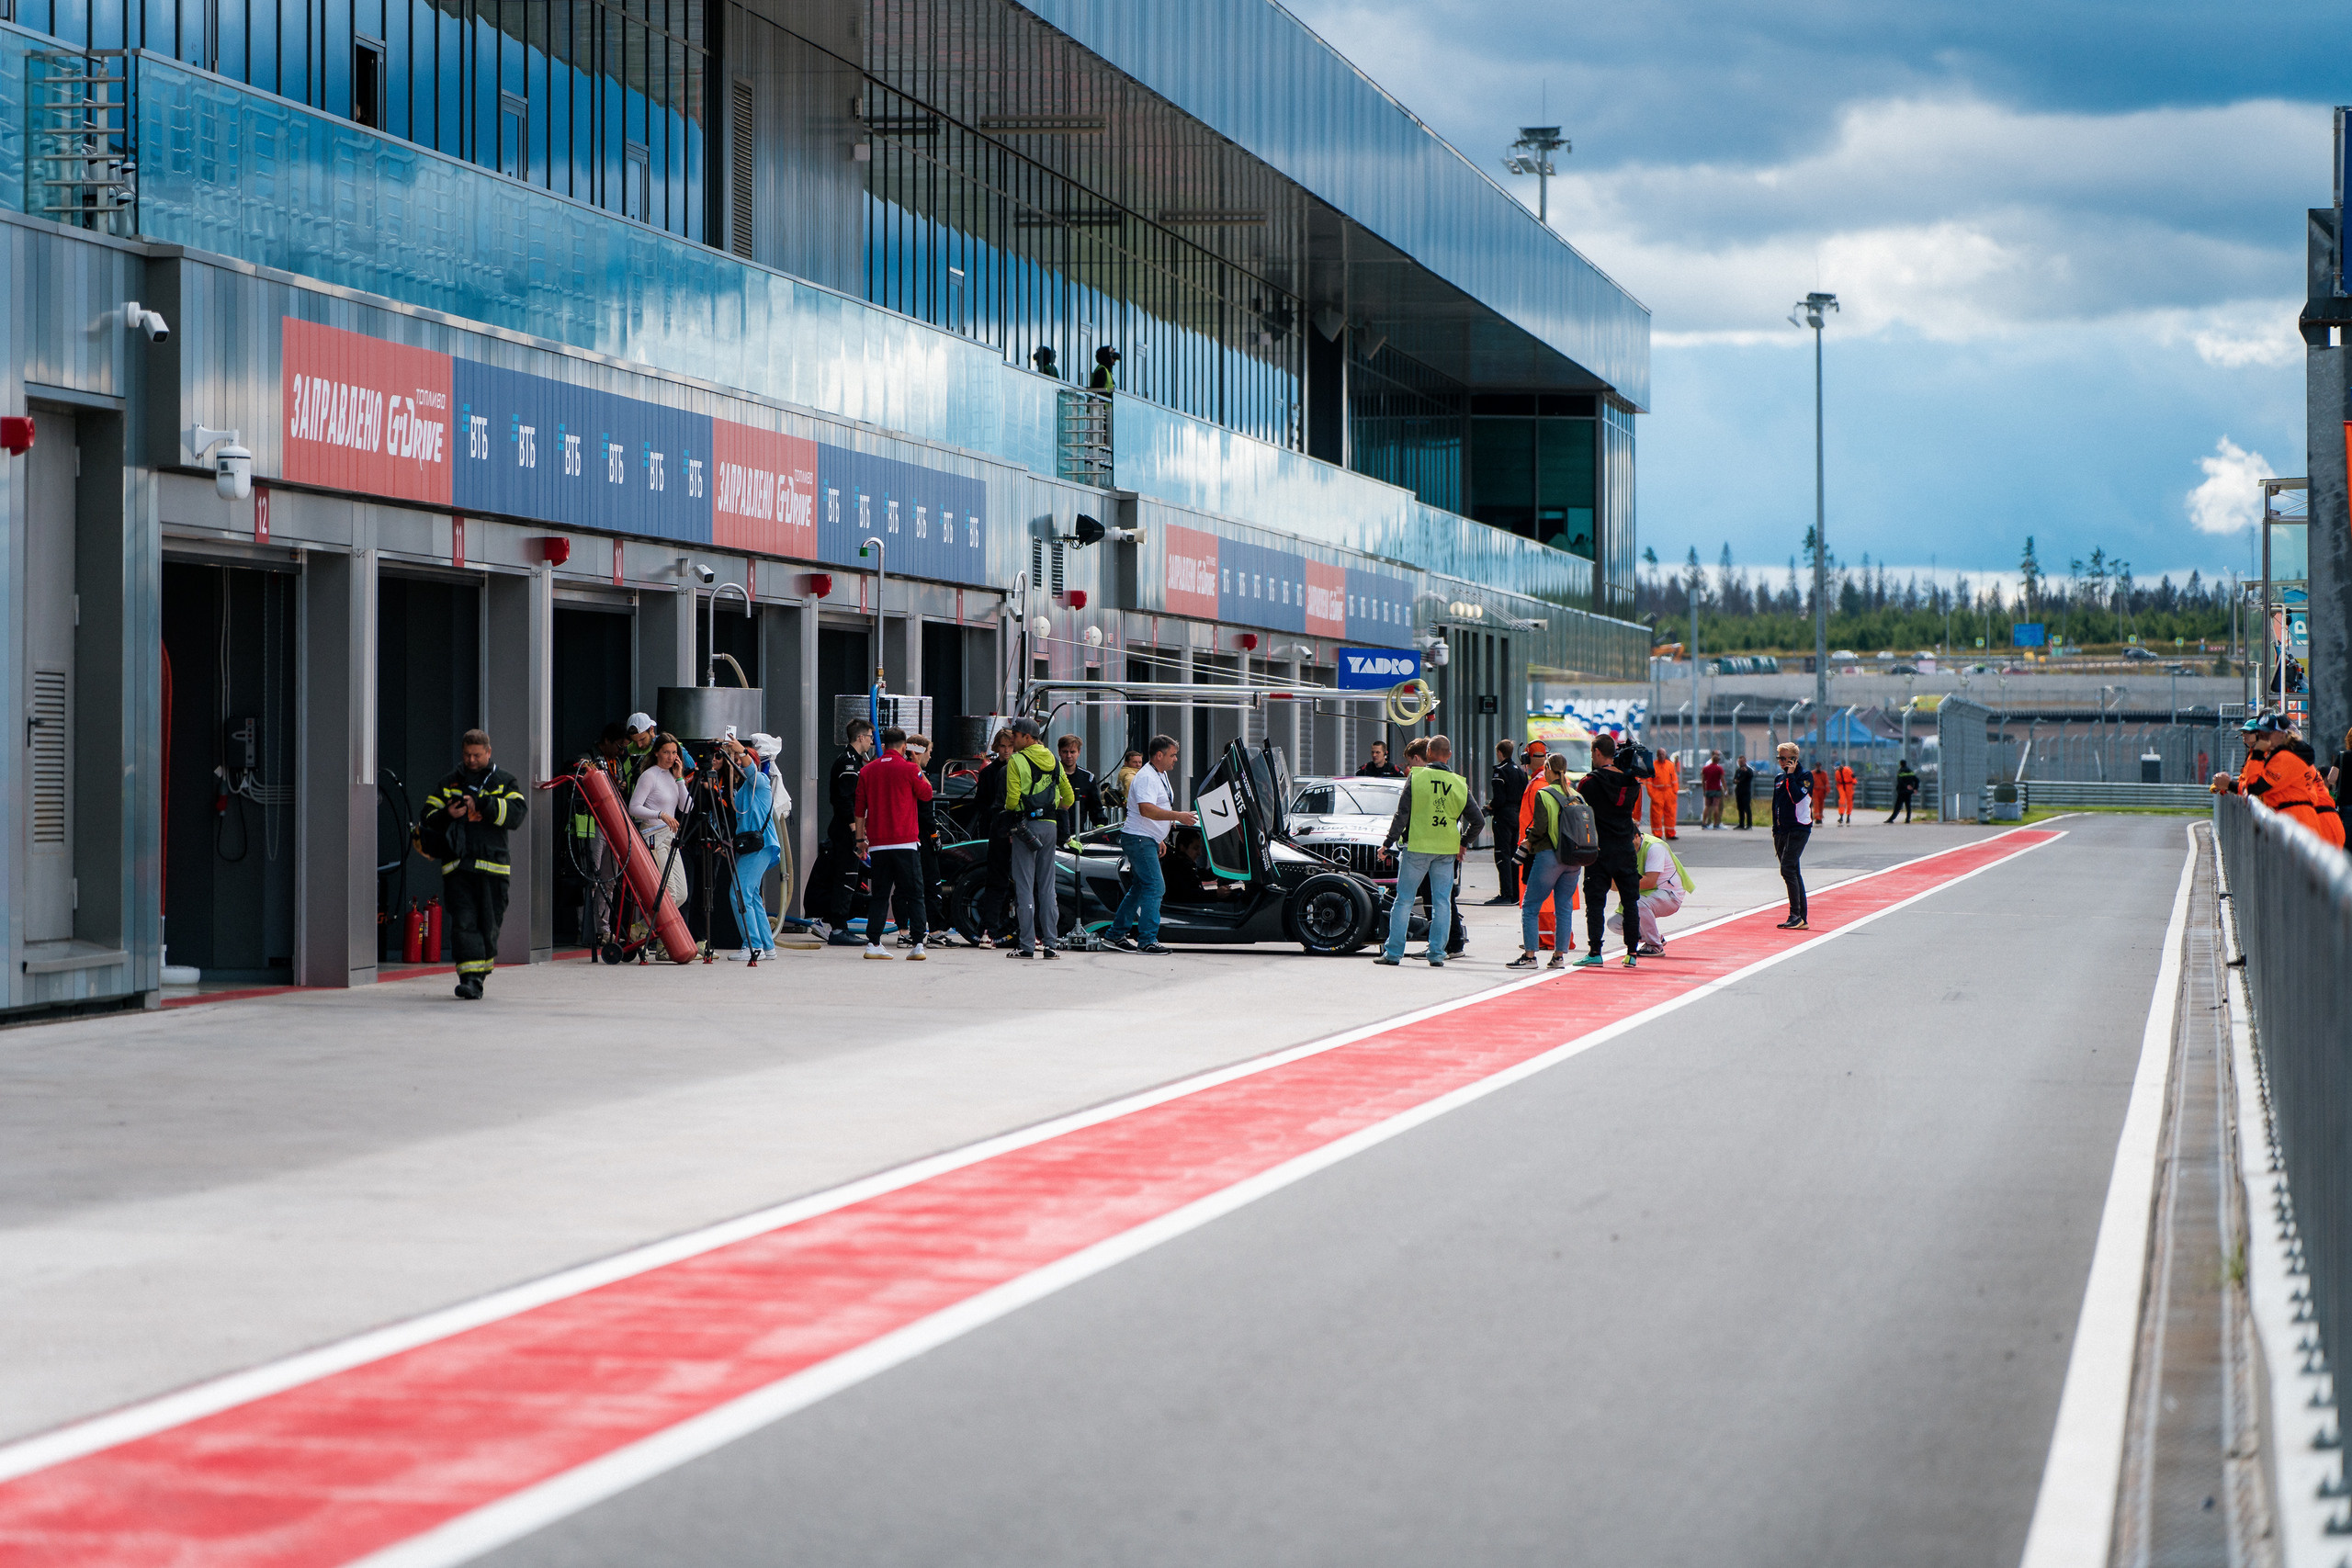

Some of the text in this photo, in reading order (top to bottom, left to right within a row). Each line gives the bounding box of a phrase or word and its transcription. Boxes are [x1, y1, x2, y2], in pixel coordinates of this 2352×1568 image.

[290, 373, 382, 453] ЗАПРАВЛЕНО
[416, 389, 446, 410] ТОПЛИВО
[470, 414, 489, 460] ВТБ
[518, 424, 536, 468] ВТБ
[565, 434, 582, 477] ВТБ
[608, 443, 624, 485] ВТБ
[650, 451, 664, 491] ВТБ
[688, 458, 703, 499] ВТБ
[718, 461, 774, 521] ЗАПРАВЛЕНО
[257, 497, 267, 534] 12
[828, 488, 840, 524] ВТБ
[859, 494, 871, 529] ВТБ
[888, 500, 899, 535] ВТБ
[916, 505, 927, 539] ВТБ
[455, 525, 462, 558] 11
[943, 511, 954, 544] ВТБ
[969, 516, 979, 548] ВТБ
[615, 547, 623, 578] 10
[748, 566, 754, 598] 9
[862, 581, 867, 608] 8
[1347, 656, 1415, 675] YADRO
[1233, 790, 1247, 815] ВТБ
[1314, 785, 1334, 795] ВТБ
[1430, 780, 1453, 796] TV
[1210, 799, 1229, 818] 7
[1431, 816, 1448, 828] 34
